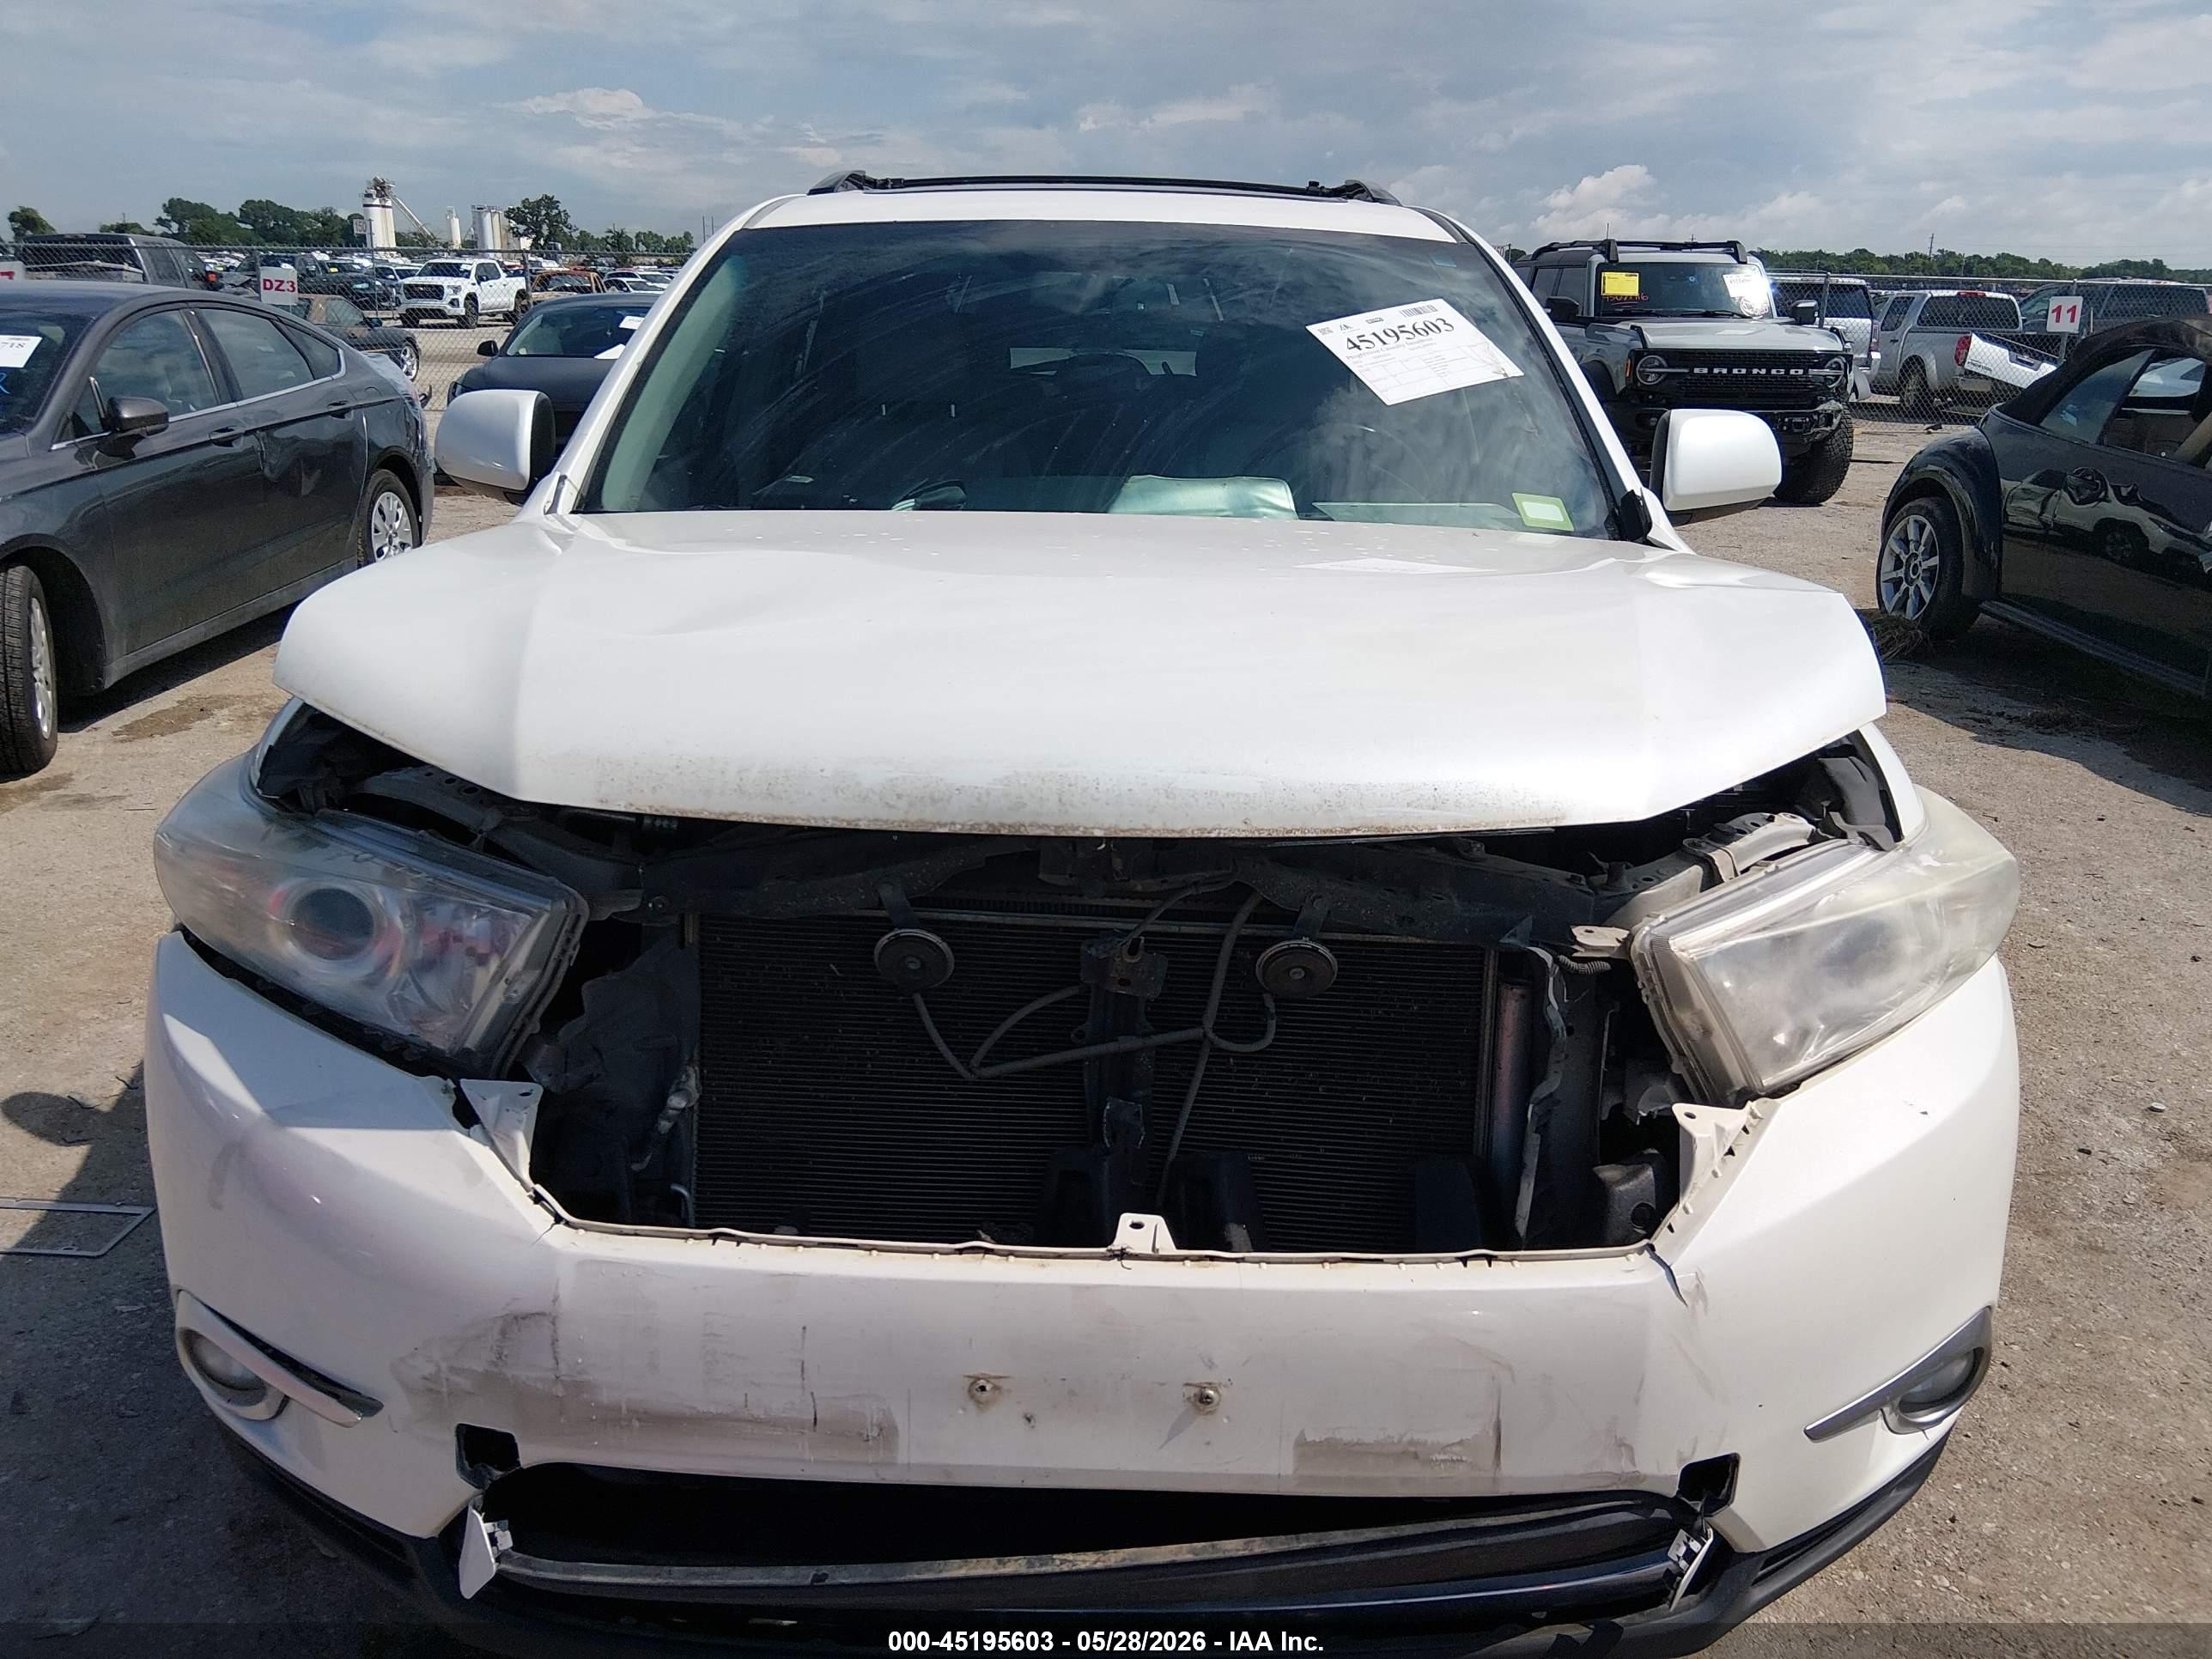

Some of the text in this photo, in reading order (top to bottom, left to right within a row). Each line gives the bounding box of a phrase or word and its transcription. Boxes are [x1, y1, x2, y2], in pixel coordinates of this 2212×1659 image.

[354, 222, 367, 233] 150
[262, 278, 296, 293] DZ3
[2051, 304, 2077, 324] 11
[1346, 318, 1455, 351] 45195603
